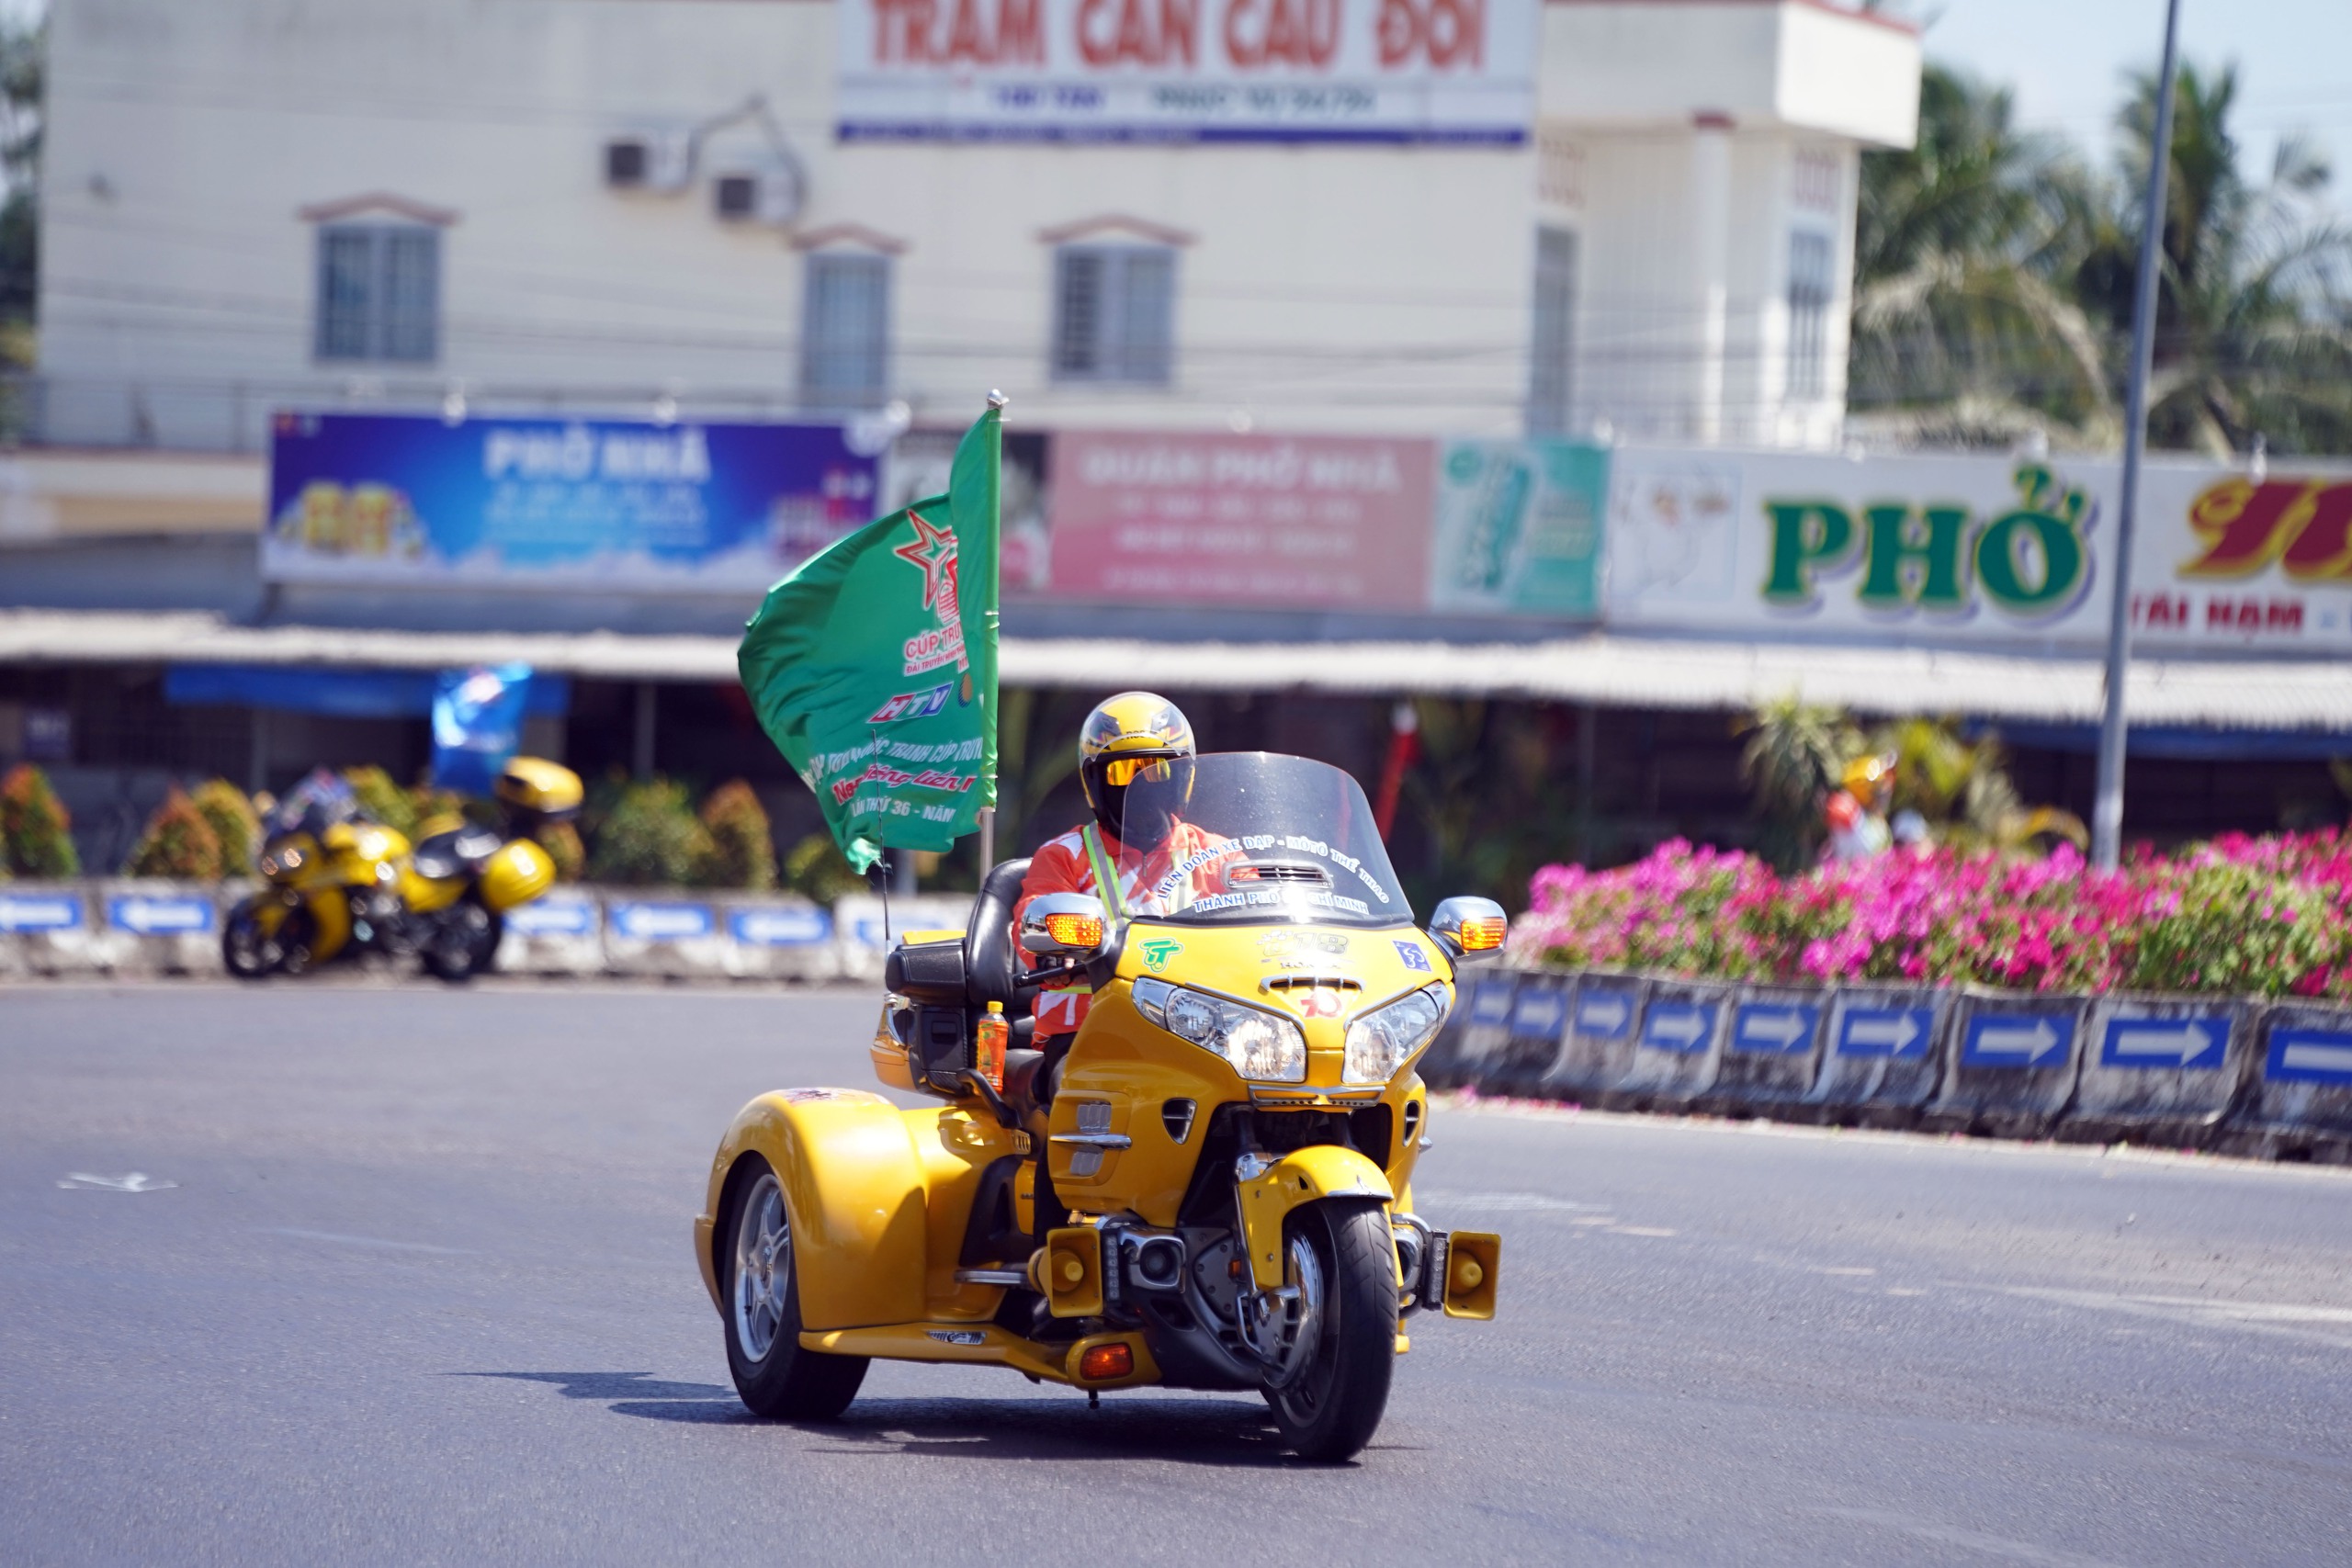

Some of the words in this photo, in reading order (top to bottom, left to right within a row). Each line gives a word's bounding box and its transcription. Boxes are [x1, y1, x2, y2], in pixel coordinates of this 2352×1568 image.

[1760, 463, 2091, 612] PHỞ
[875, 687, 952, 719] HTV
[891, 799, 911, 817] 36
[1221, 838, 1242, 853] XE
[1332, 895, 1369, 916] MINH
